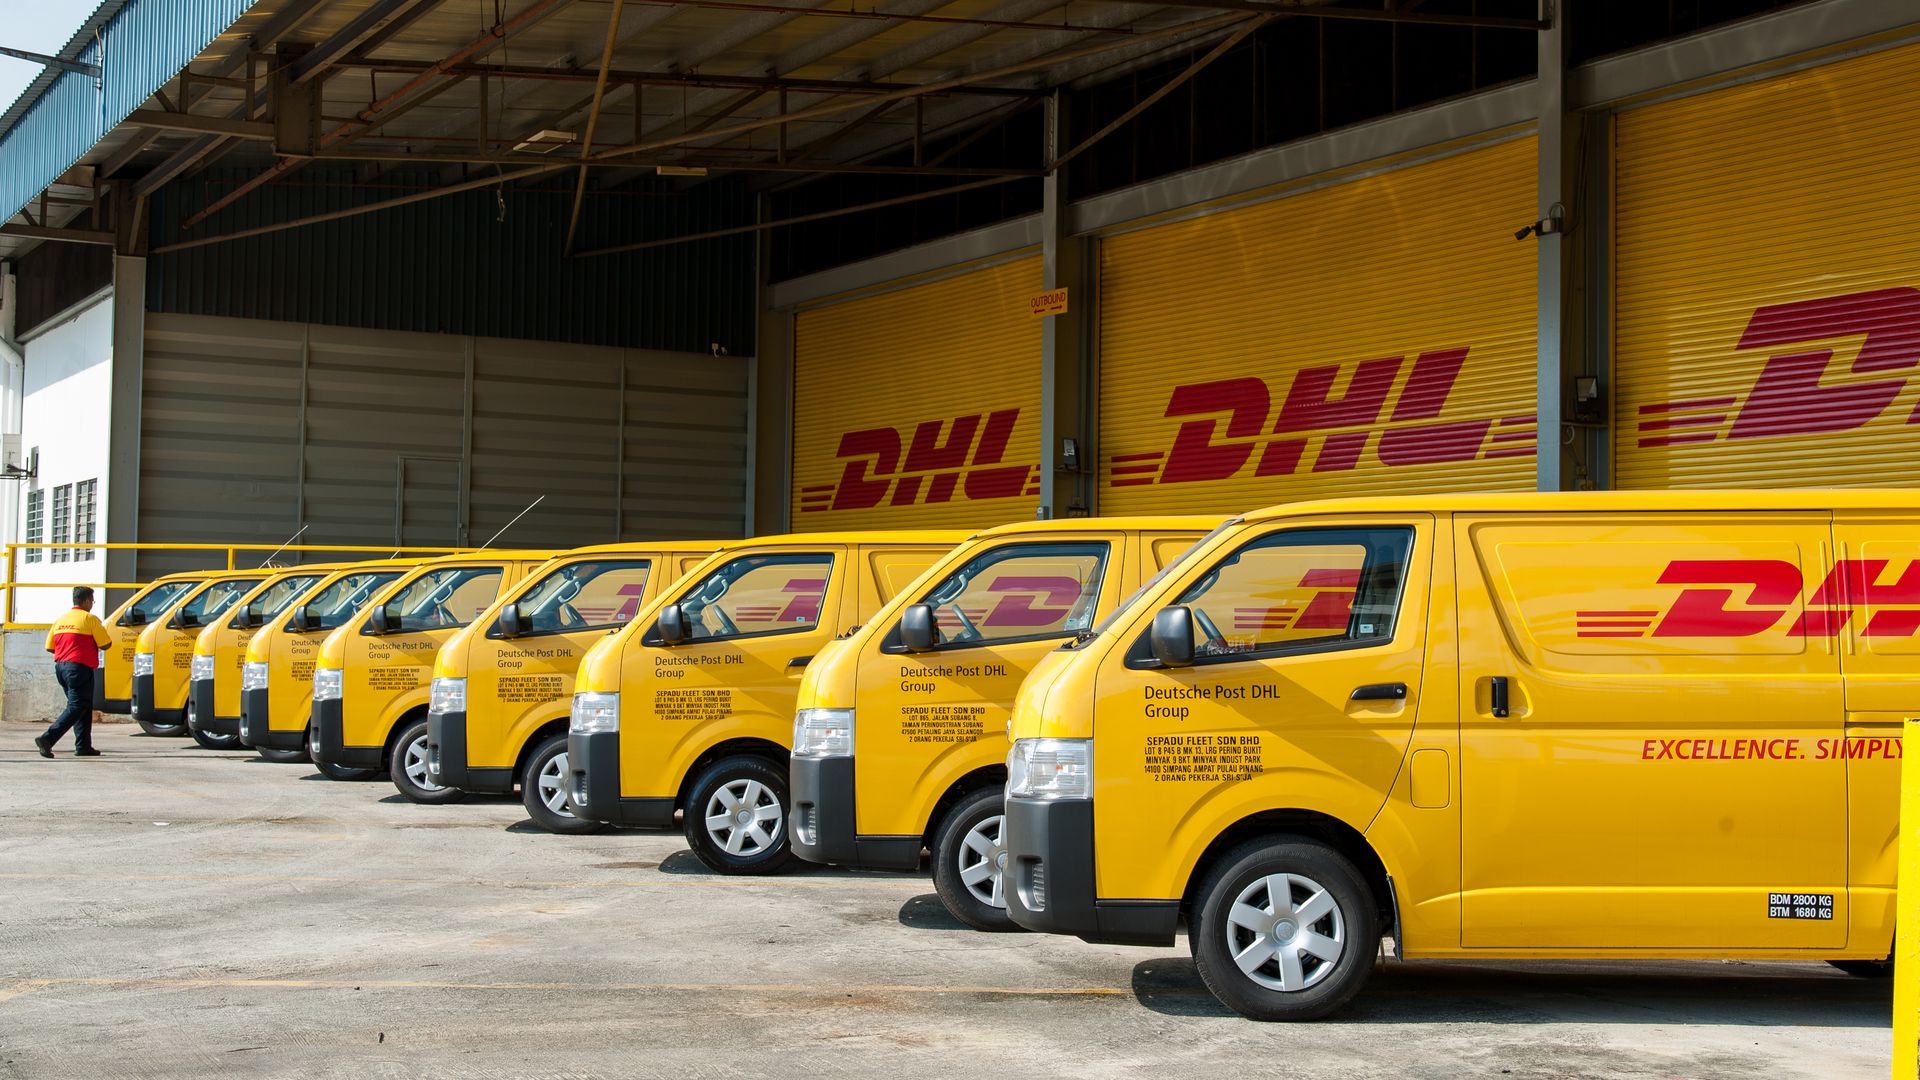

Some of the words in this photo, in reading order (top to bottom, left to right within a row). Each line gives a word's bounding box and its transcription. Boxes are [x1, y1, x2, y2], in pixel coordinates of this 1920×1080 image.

[1031, 292, 1066, 308] OUTBOUND
[1159, 346, 1492, 483] DHL
[831, 408, 1032, 510] DHL
[368, 642, 401, 650] Deutsche
[368, 651, 390, 660] Group
[497, 649, 535, 658] Deutsche
[536, 649, 554, 657] Post
[556, 648, 573, 657] DHL
[497, 659, 523, 669] Group
[655, 656, 699, 666] Deutsche
[701, 655, 721, 665] Post
[724, 654, 744, 664] DHL
[655, 668, 685, 679] Group
[900, 665, 953, 677] Deutsche
[956, 665, 980, 677] Post
[984, 664, 1007, 676] DHL
[900, 680, 936, 694] Group
[1144, 684, 1211, 699] Deutsche
[1215, 685, 1245, 699] Post
[1252, 685, 1280, 699] DHL
[901, 707, 929, 715] SEPADU
[931, 707, 950, 715] FLEET
[953, 707, 968, 715] SDN
[970, 707, 985, 715] BHD
[1144, 704, 1189, 721] Group
[1146, 736, 1183, 745] SEPADU
[1187, 736, 1213, 745] FLEET
[1217, 736, 1236, 745] SDN
[1240, 736, 1260, 745] BHD
[1144, 747, 1155, 755] LOT
[1158, 747, 1162, 755] 8
[1163, 747, 1175, 755] P45
[1176, 747, 1181, 755] B
[1183, 747, 1193, 755] MK
[1205, 747, 1217, 755] LRG
[1219, 747, 1241, 755] PERIND
[1243, 747, 1262, 755] BUKIT
[1641, 739, 1805, 760] EXCELLENCE.
[1146, 756, 1171, 764] MINYAK
[1172, 756, 1177, 764] 9
[1178, 756, 1190, 764] BKT
[1192, 756, 1217, 764] MINYAK
[1220, 756, 1242, 764] INDUST
[1244, 756, 1261, 764] PARK
[1144, 765, 1161, 773] 14100
[1162, 765, 1191, 773] SIMPANG
[1194, 765, 1215, 773] AMPAT
[1217, 765, 1238, 773] PULAU
[1239, 765, 1264, 773] PINANG
[1770, 894, 1791, 905] BDM
[1793, 894, 1816, 905] 2800
[1818, 895, 1832, 906] KG
[1770, 907, 1790, 917] BTM
[1794, 907, 1816, 918] 1680
[1818, 908, 1832, 918] KG
